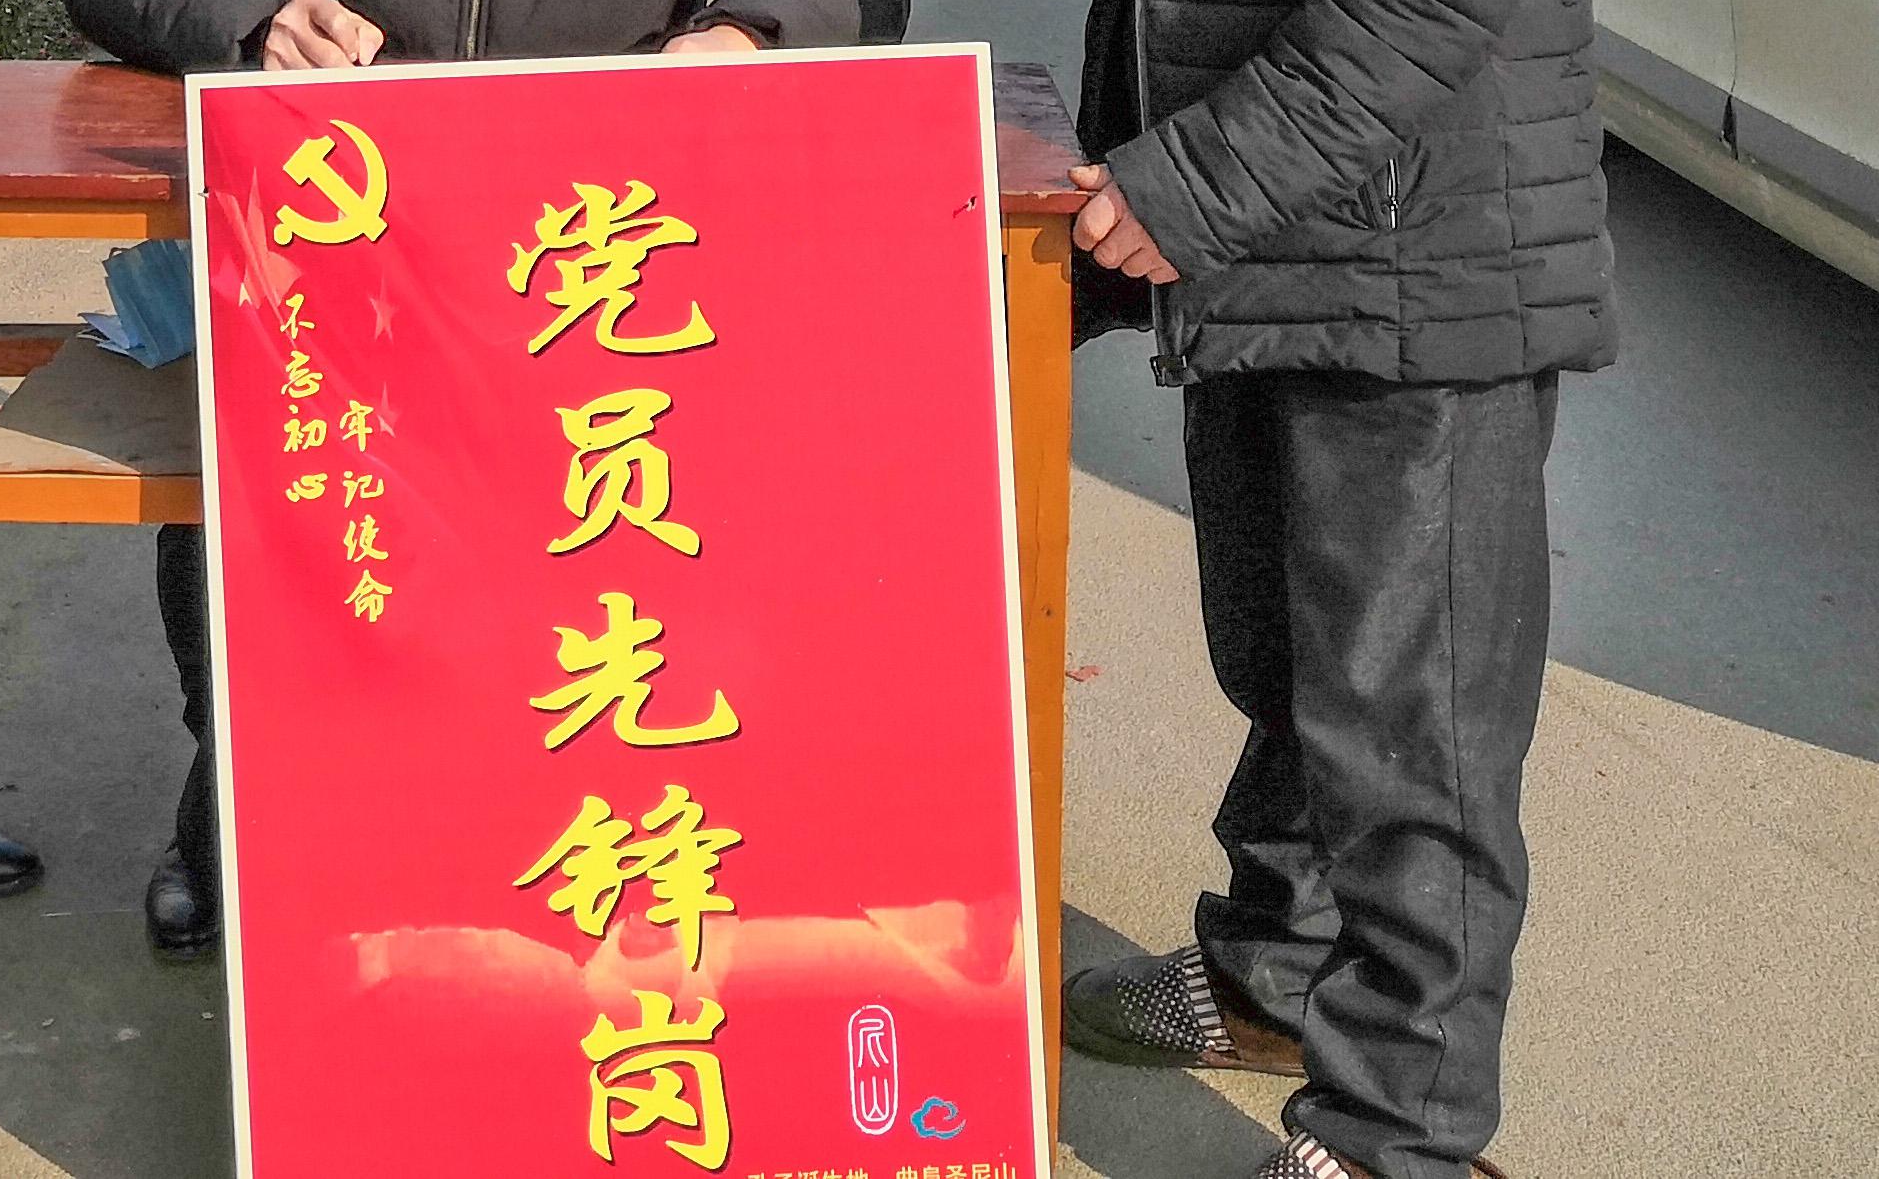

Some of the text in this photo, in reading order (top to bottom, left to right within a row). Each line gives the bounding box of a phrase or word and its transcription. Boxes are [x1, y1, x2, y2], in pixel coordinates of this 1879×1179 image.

[280, 293, 328, 503] 不忘初心
[339, 399, 393, 623] 牢记使命
[506, 179, 741, 1171] 党员先锋岗
